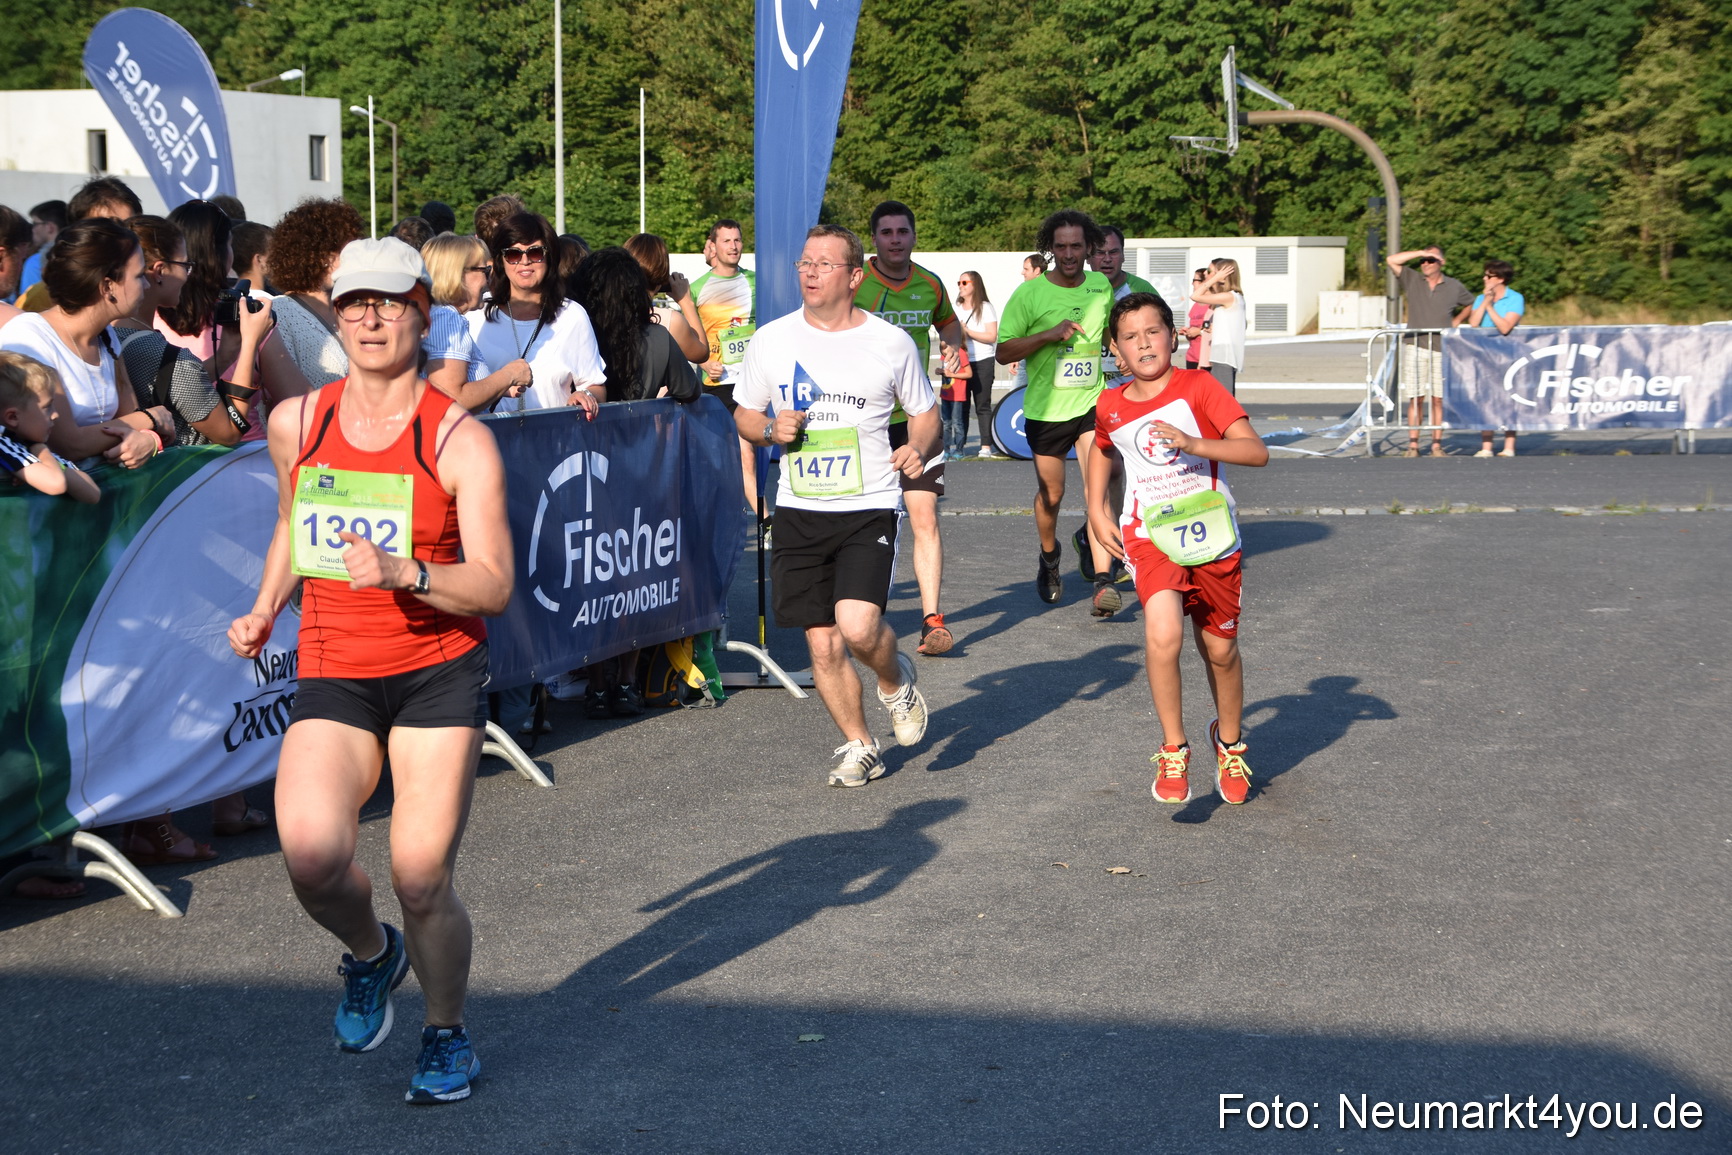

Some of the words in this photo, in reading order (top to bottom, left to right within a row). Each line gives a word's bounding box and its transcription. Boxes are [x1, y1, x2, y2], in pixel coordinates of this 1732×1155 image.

[1064, 362, 1092, 377] 263
[1537, 369, 1692, 398] Fischer
[227, 405, 246, 428] SONY
[801, 407, 839, 421] Team
[1550, 400, 1679, 414] AUTOMOBILE
[794, 455, 851, 478] 1477
[1183, 462, 1205, 475] HERZ
[303, 513, 398, 553] 1392
[1173, 521, 1207, 548] 79
[572, 577, 680, 628] AUTOMOBILE
